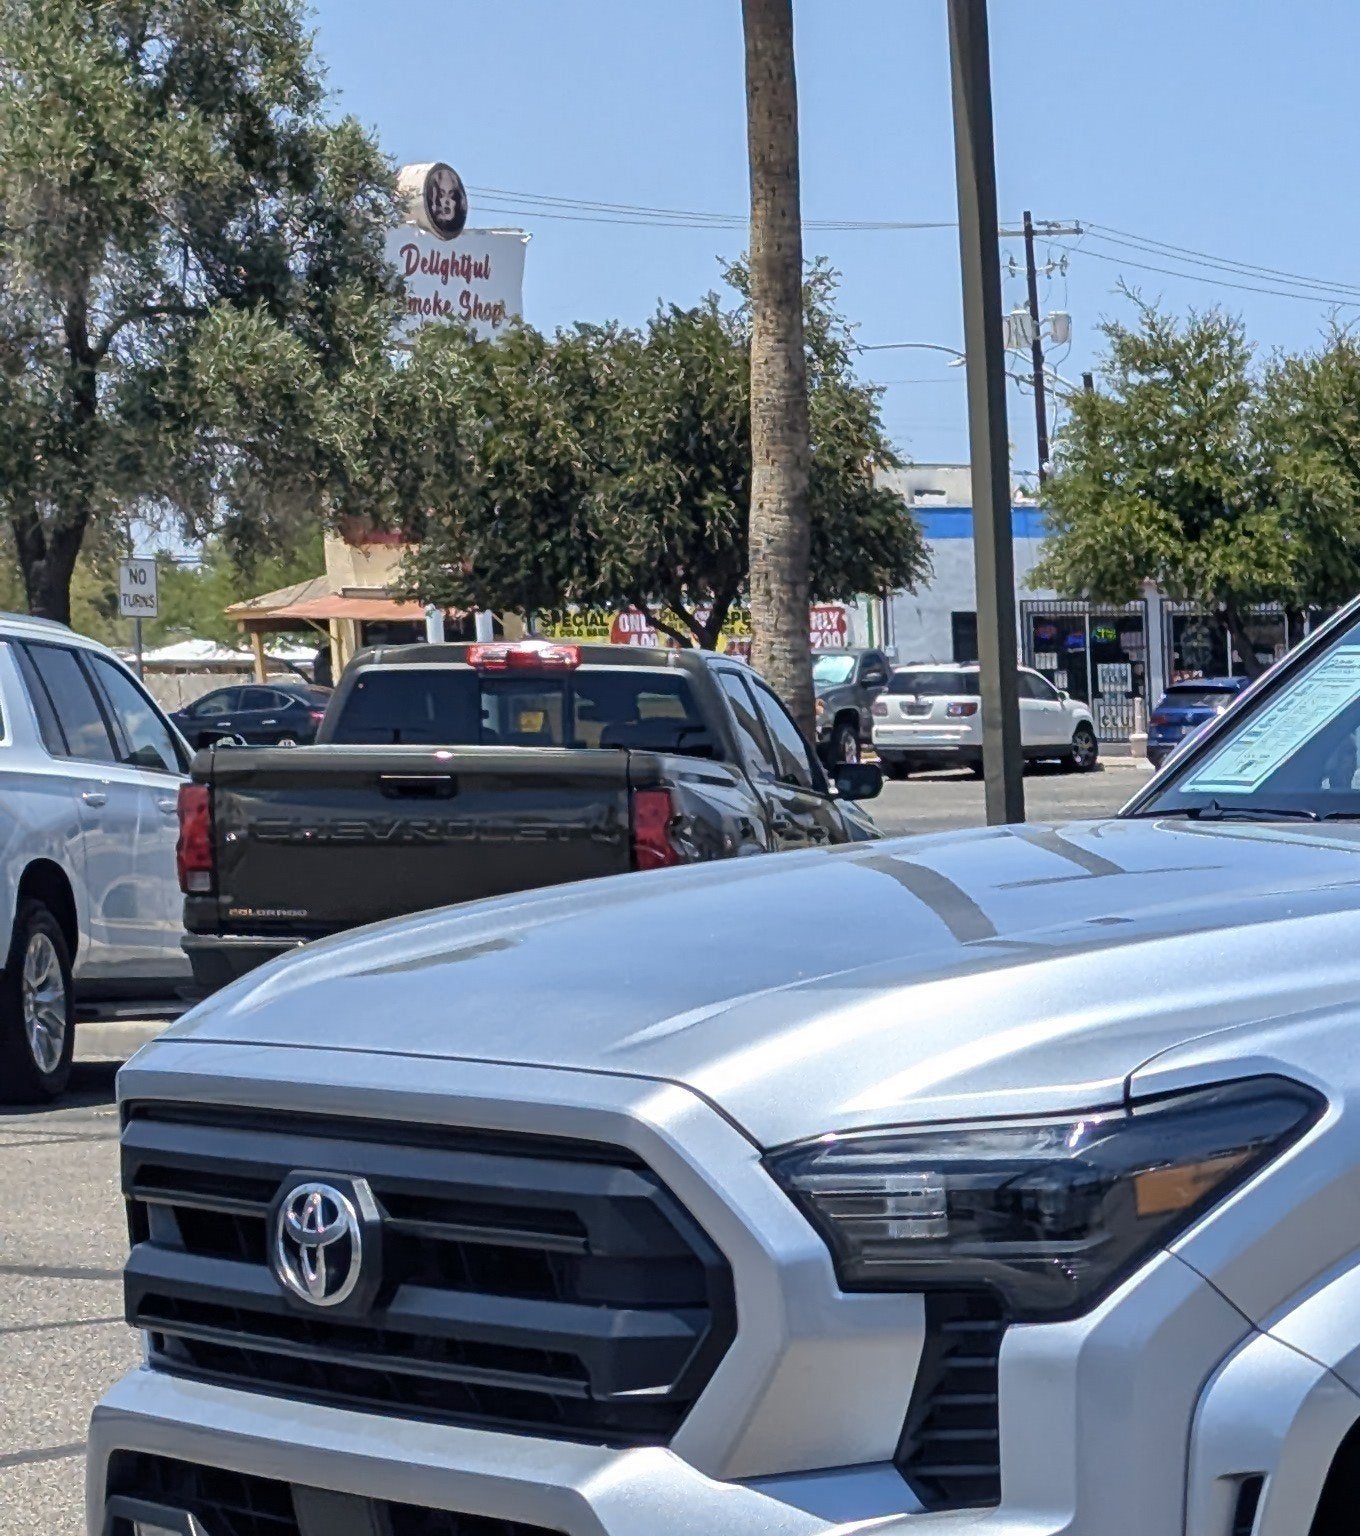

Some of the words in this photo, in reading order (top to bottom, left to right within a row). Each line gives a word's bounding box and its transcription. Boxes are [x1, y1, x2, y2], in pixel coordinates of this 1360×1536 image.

[400, 243, 491, 285] Delightful
[405, 290, 454, 317] moke
[459, 289, 506, 329] Shop
[128, 568, 147, 585] NO
